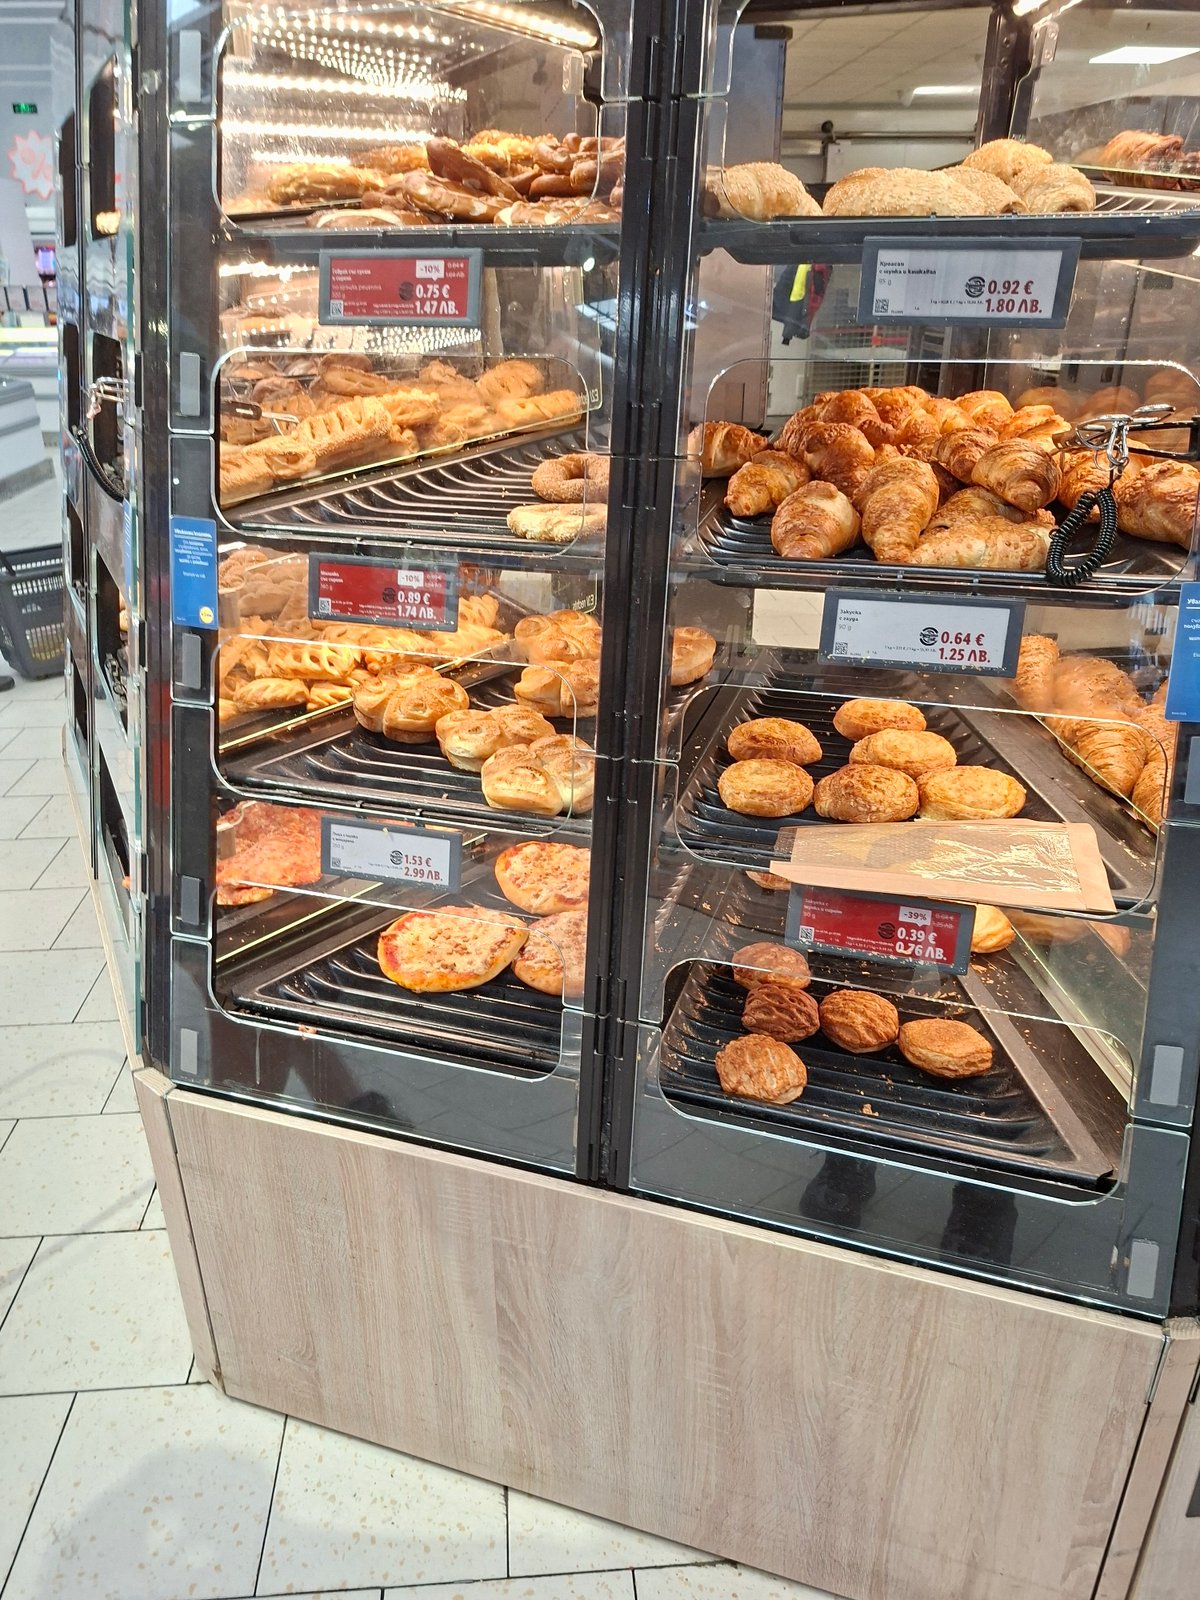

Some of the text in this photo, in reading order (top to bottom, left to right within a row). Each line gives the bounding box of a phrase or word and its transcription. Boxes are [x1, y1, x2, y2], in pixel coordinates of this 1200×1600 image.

[420, 264, 441, 274] -10%
[415, 284, 440, 299] 0.75
[442, 284, 450, 299] €
[987, 280, 1020, 295] 0.92
[1023, 280, 1034, 295] €
[415, 300, 438, 315] 1.47
[439, 300, 459, 315] ЛВ.
[985, 298, 1043, 314] 1.80 ЛВ.
[401, 573, 420, 583] -10%
[397, 591, 421, 604] 0.89
[423, 592, 431, 605] €
[397, 605, 417, 618] 1.74
[419, 607, 437, 620] ЛВ.
[940, 631, 971, 645] 0.64
[975, 633, 985, 646] €
[938, 647, 965, 661] 1.25
[967, 649, 991, 663] ЛВ.
[404, 854, 423, 866] 1.53
[425, 857, 433, 868] €
[404, 866, 425, 878] 2.99
[426, 869, 443, 882] ЛВ.
[903, 910, 927, 921] -39%
[896, 927, 925, 942] 0.39
[927, 931, 937, 945] €
[895, 941, 923, 956] 0.76
[925, 947, 947, 961] ЛВ.
